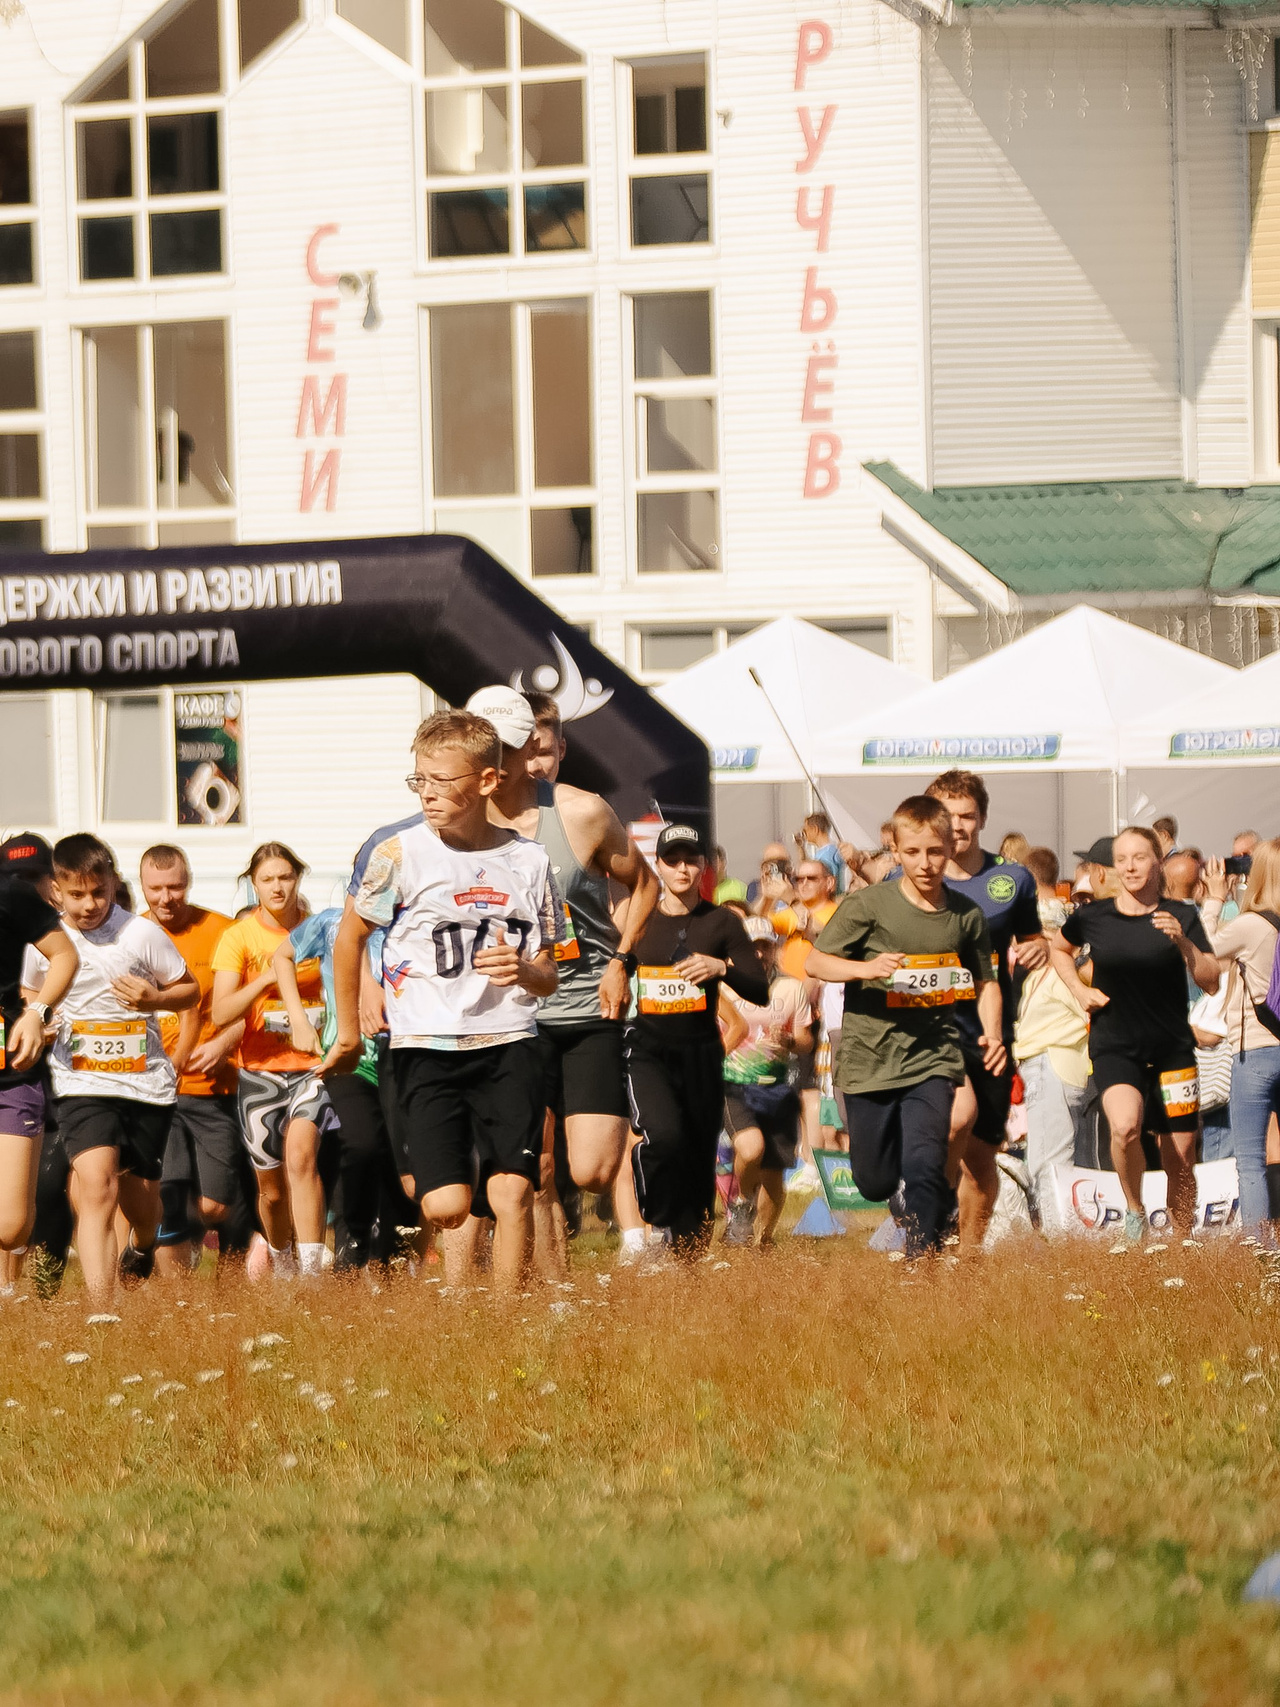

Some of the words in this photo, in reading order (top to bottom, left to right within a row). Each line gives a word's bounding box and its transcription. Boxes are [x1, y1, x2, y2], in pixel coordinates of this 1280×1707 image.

[793, 20, 843, 499] РУЧЬЁВ
[296, 223, 348, 514] СЕМИ
[132, 570, 159, 616] И
[165, 561, 344, 613] РАЗВИТИЯ
[112, 629, 241, 674] СПОРТА
[658, 984, 686, 996] 309
[908, 974, 938, 990] 268
[653, 1001, 695, 1011] WOOD
[93, 1041, 126, 1055] 323
[86, 1061, 135, 1071] WOOD
